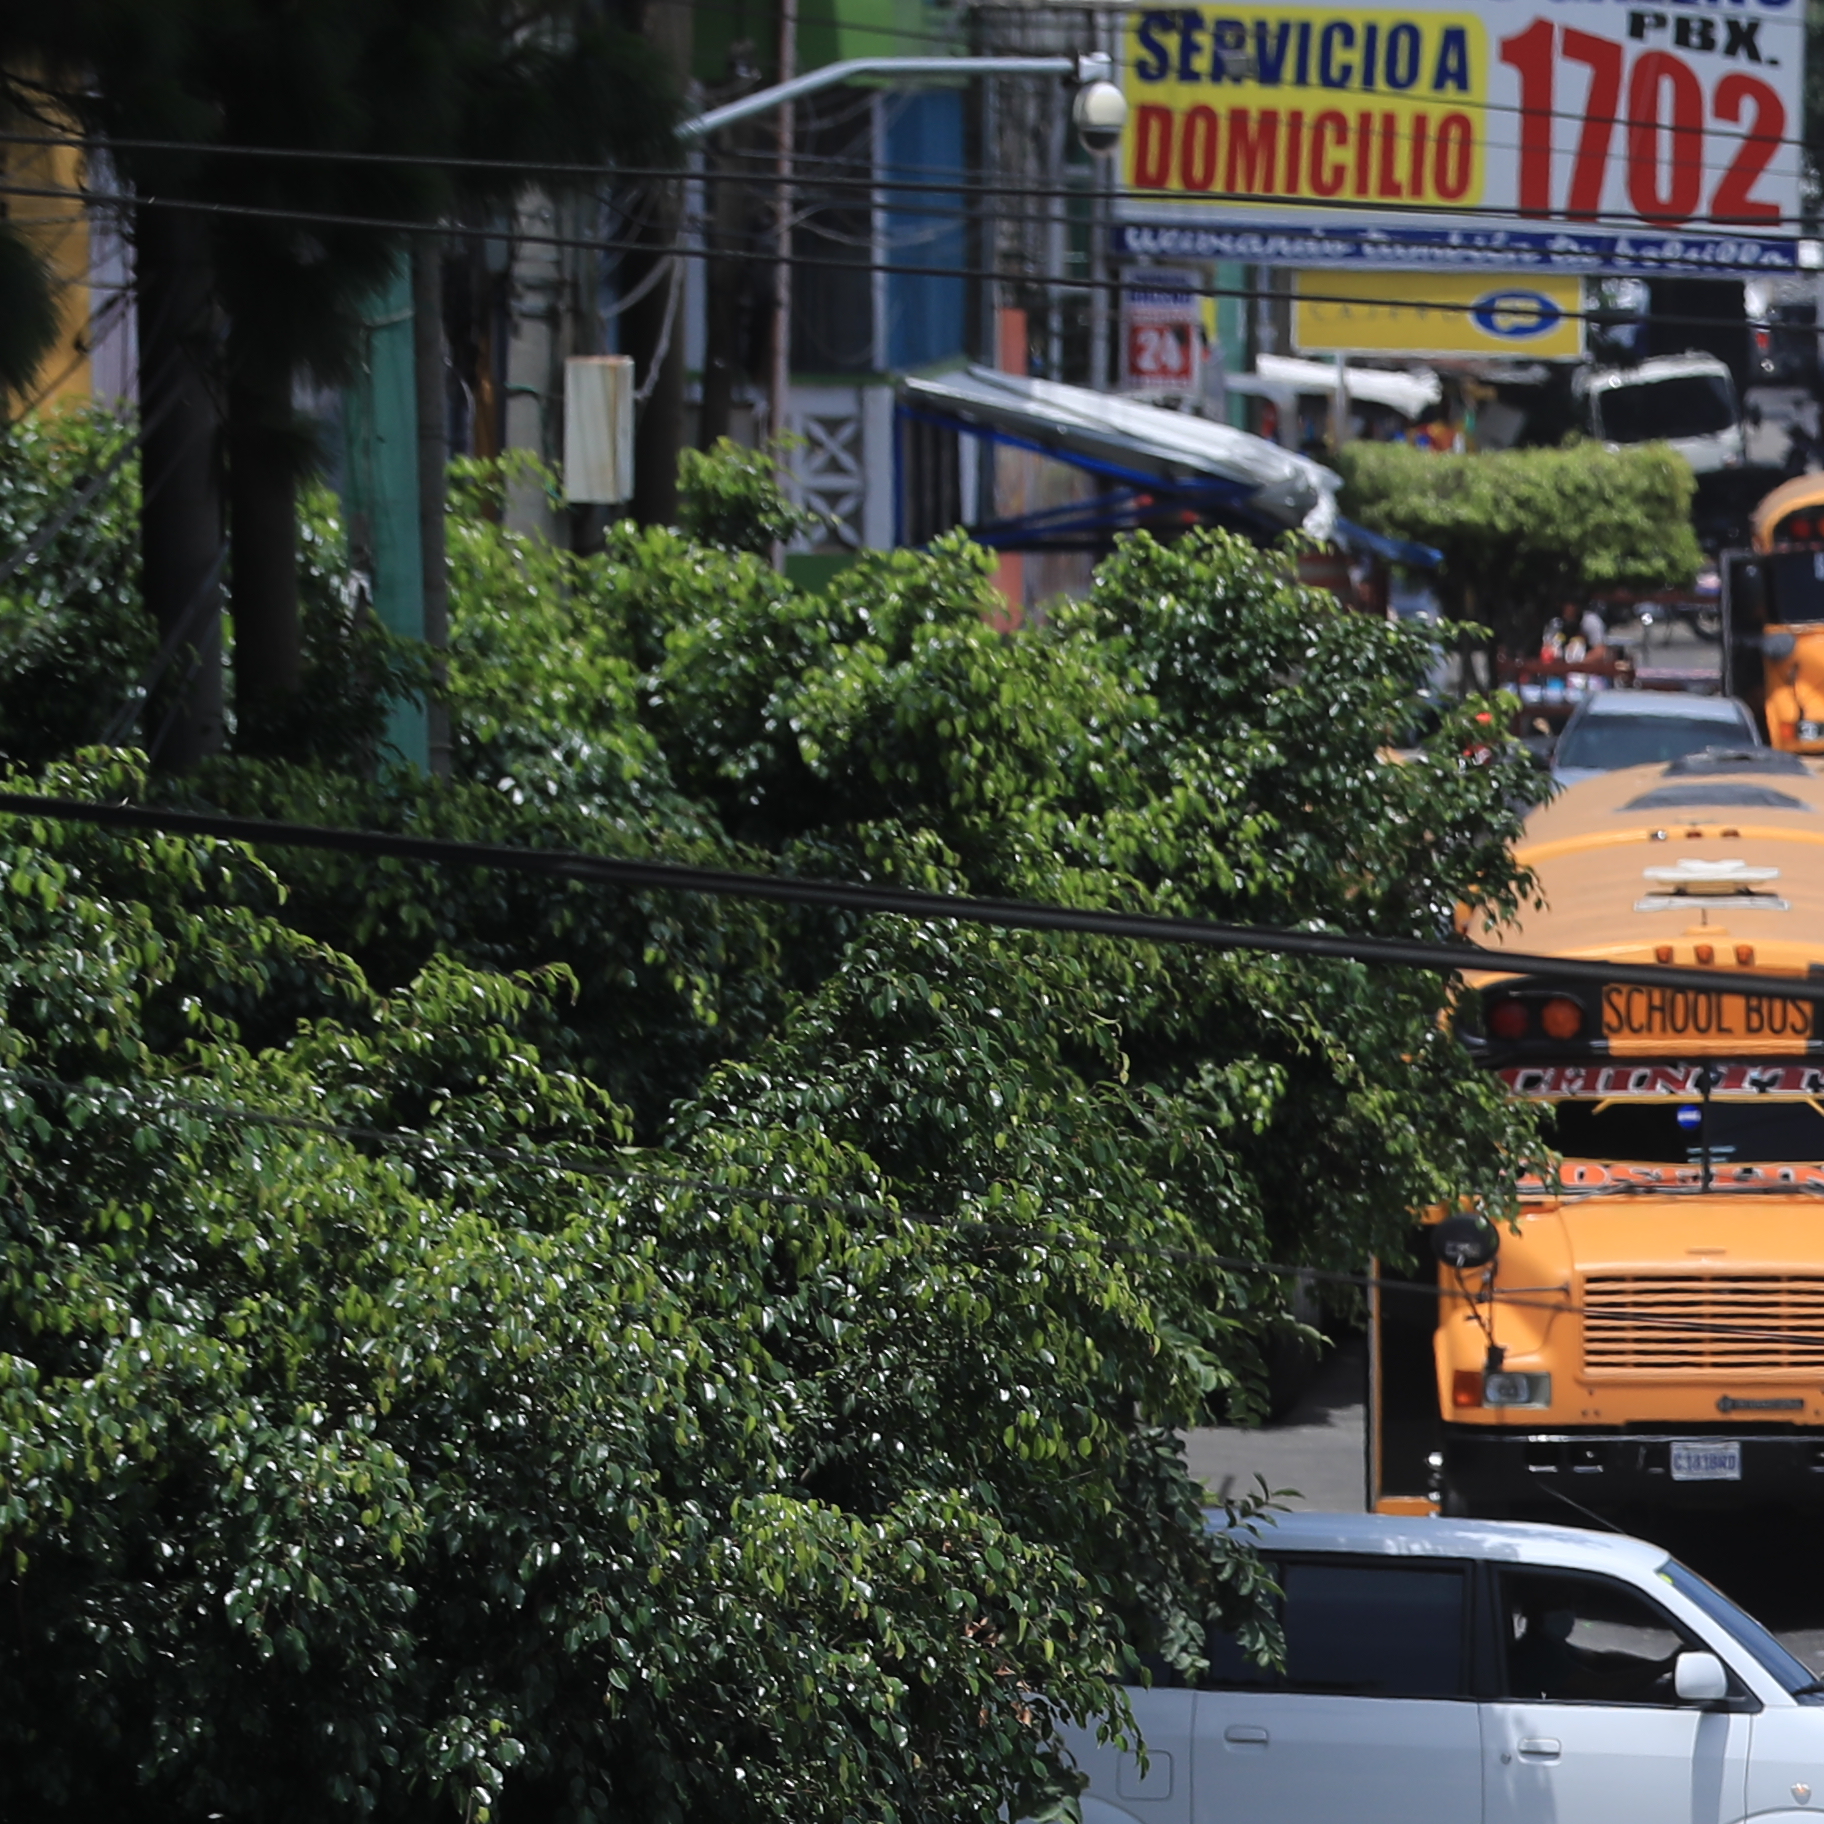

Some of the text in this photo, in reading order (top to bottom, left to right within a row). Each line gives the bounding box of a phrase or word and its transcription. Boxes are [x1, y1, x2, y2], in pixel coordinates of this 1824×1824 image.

[1136, 8, 1471, 92] SERVICIO A
[1133, 102, 1473, 203] DOMICILIO
[1499, 16, 1786, 228] 1702
[1603, 985, 1811, 1036] SCHOOL BUS
